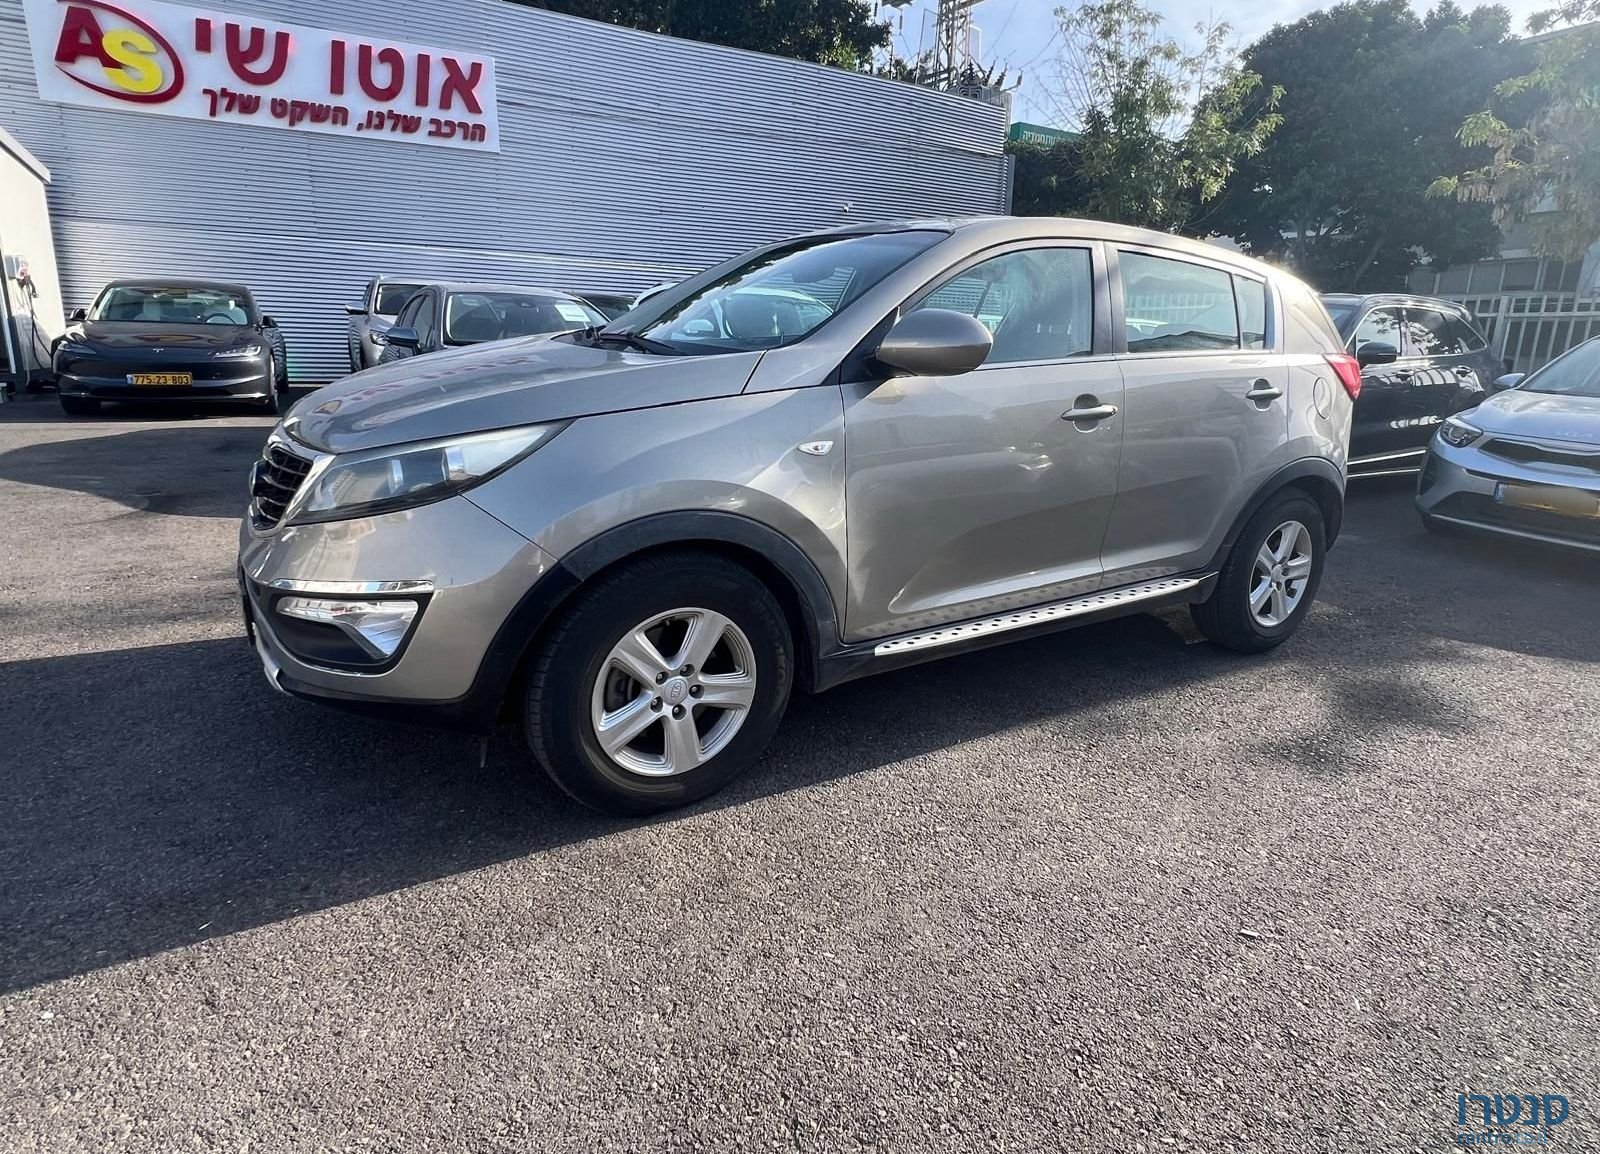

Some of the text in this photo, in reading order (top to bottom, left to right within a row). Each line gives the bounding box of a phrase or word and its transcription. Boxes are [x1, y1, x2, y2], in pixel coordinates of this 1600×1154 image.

[55, 6, 163, 93] AS
[195, 17, 483, 114] אוטו שי
[202, 87, 487, 142] הרכב שלנו, השקט שלך
